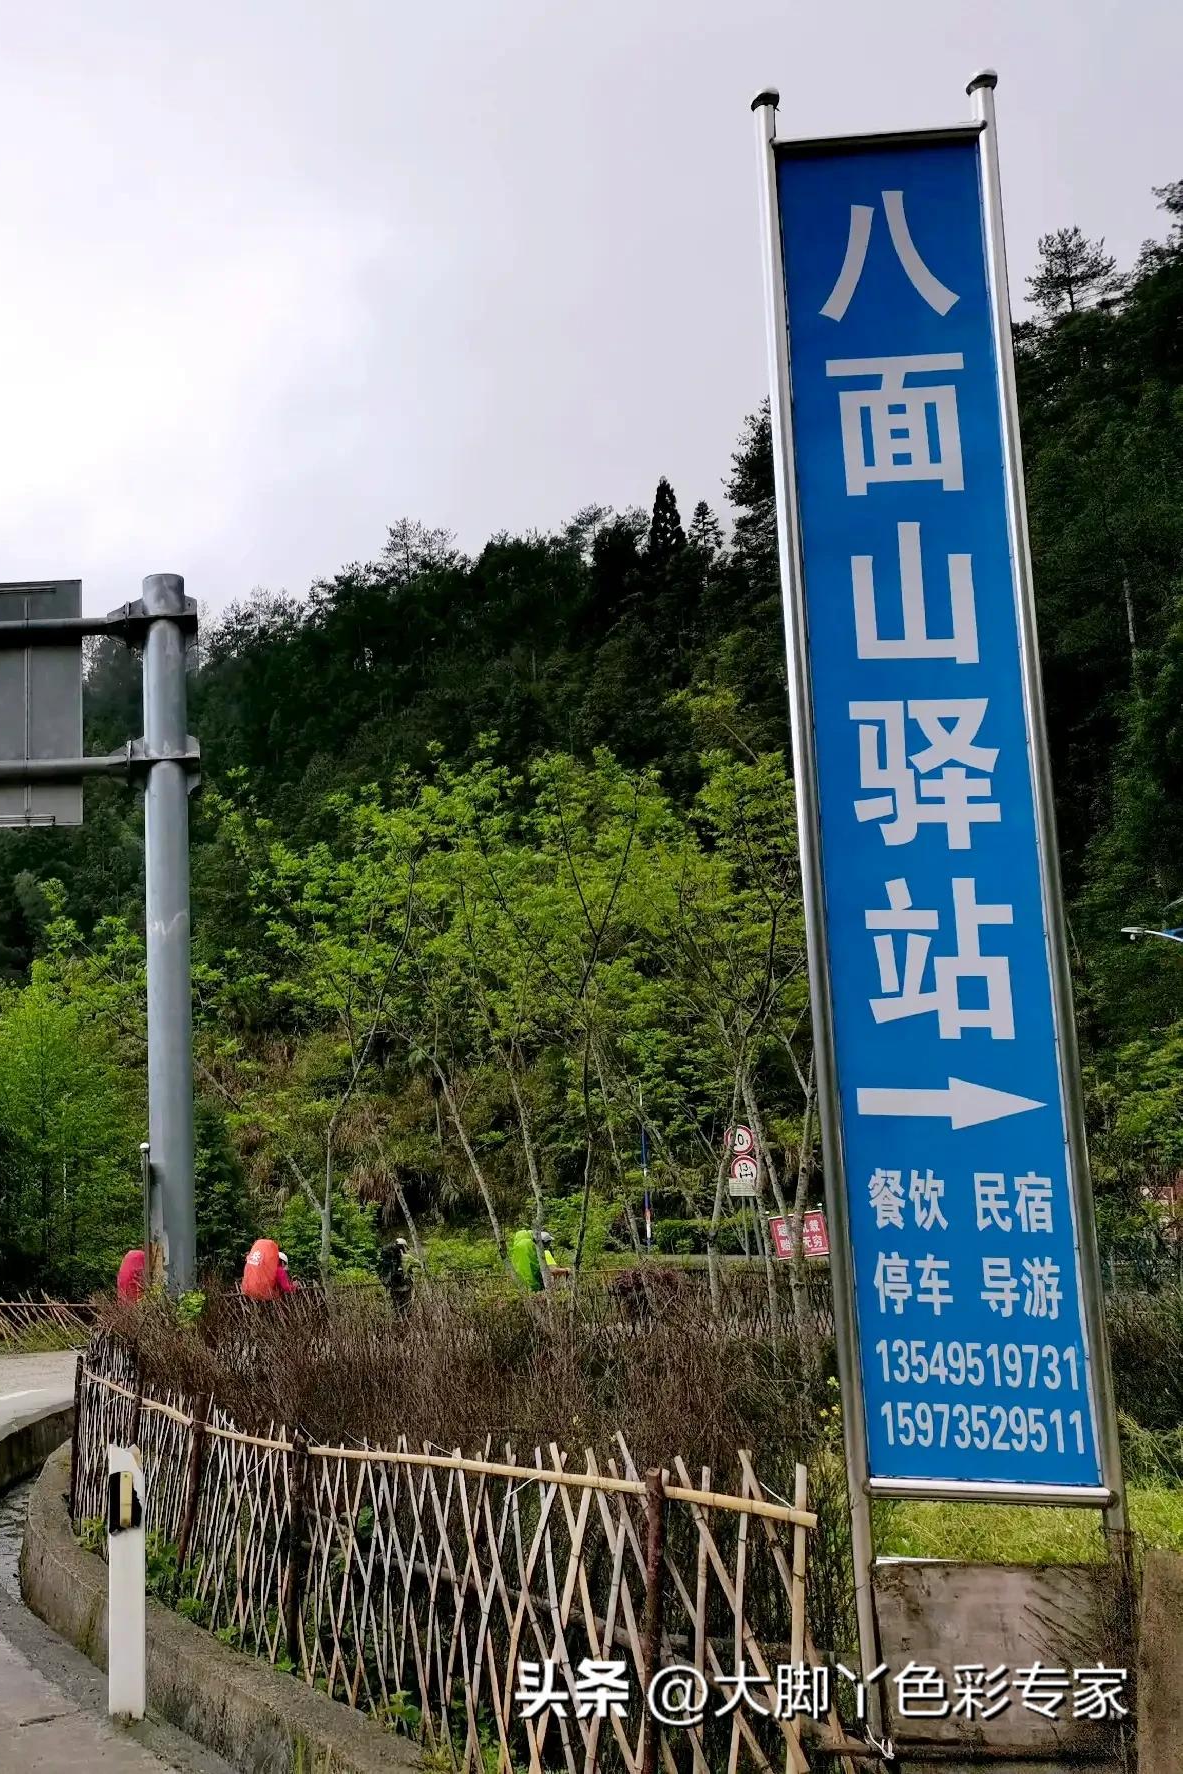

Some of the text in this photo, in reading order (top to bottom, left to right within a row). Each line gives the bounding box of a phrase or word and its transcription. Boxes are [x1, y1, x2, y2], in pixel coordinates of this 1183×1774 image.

[819, 190, 1016, 1041] 八面山驿站
[867, 1167, 1054, 1233] 餐饮 民宿
[873, 1251, 1064, 1320] 停车 导游
[875, 1339, 1080, 1391] 13549519731
[880, 1401, 1085, 1455] 15973529511
